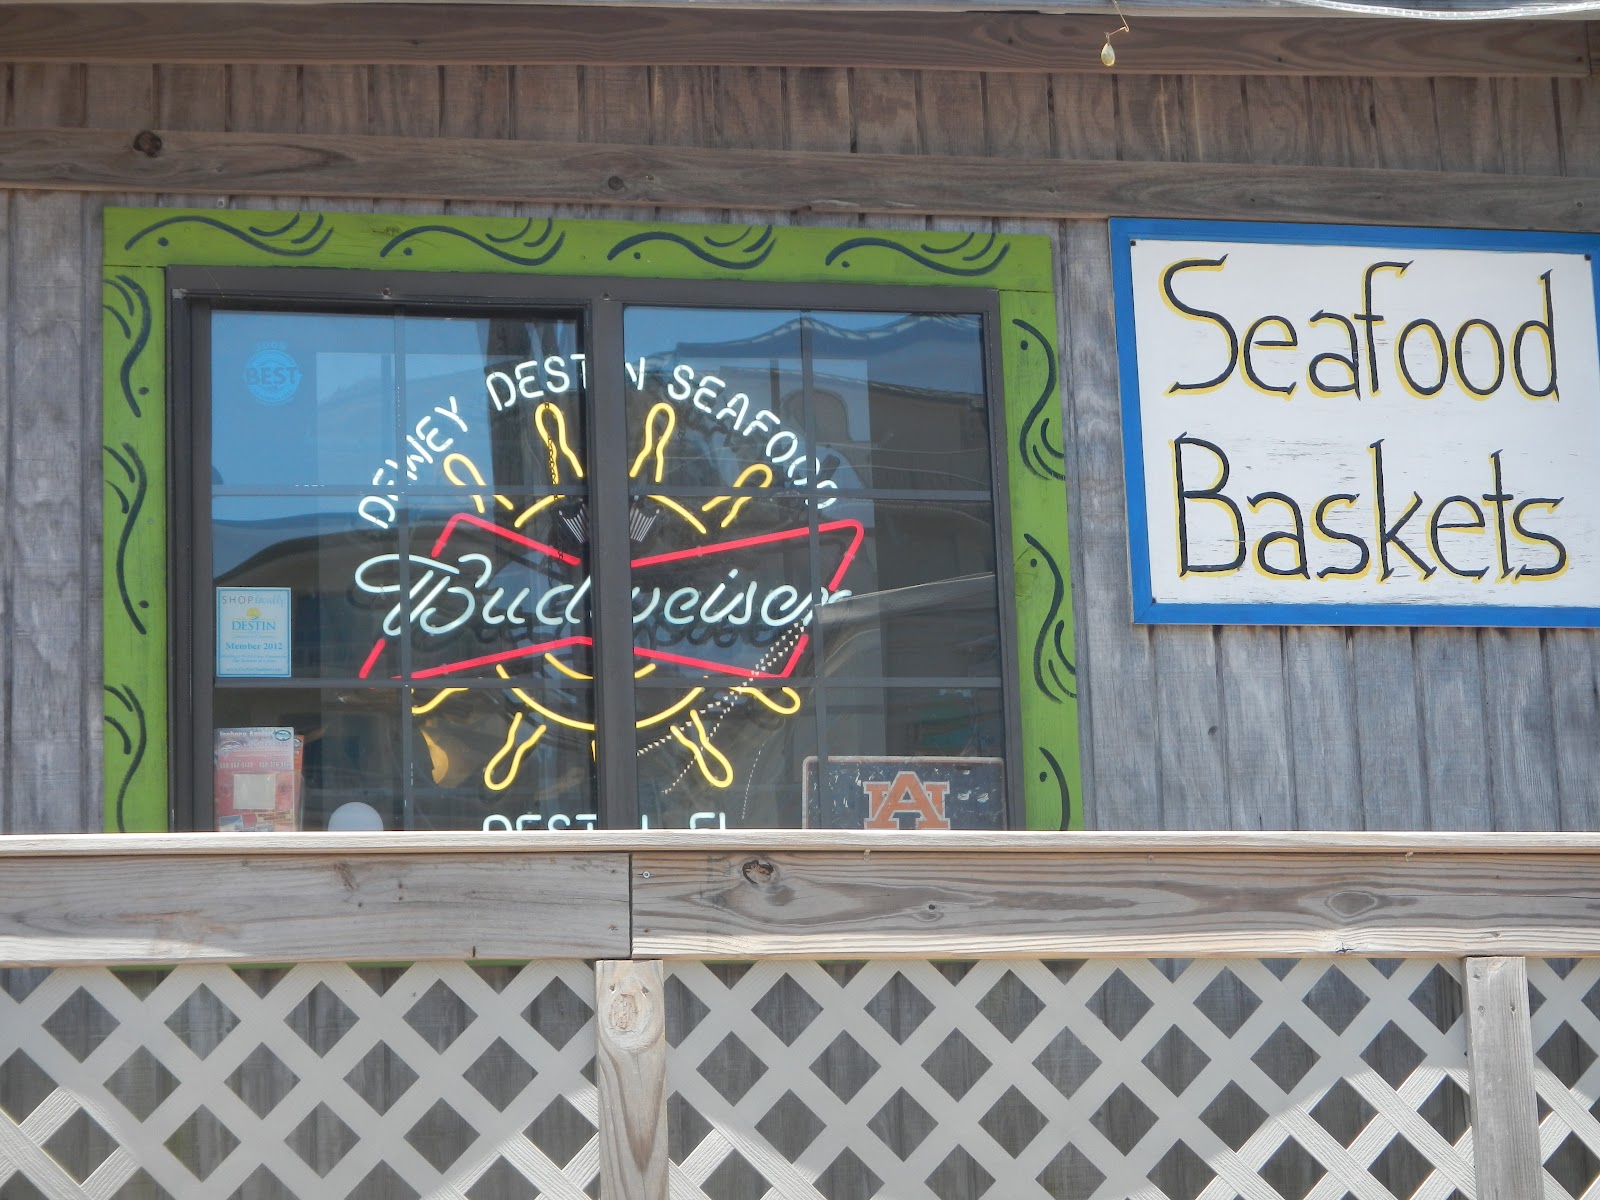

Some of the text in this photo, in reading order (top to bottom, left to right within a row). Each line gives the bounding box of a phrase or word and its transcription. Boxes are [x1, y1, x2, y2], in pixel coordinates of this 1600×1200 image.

[1158, 253, 1560, 402] Seafood
[246, 367, 297, 385] BEST
[486, 353, 646, 411] DESTN
[1168, 431, 1570, 585] Baskets
[222, 595, 254, 605] SHOP
[232, 620, 276, 631] DESTIN
[225, 642, 283, 650] Member 2012
